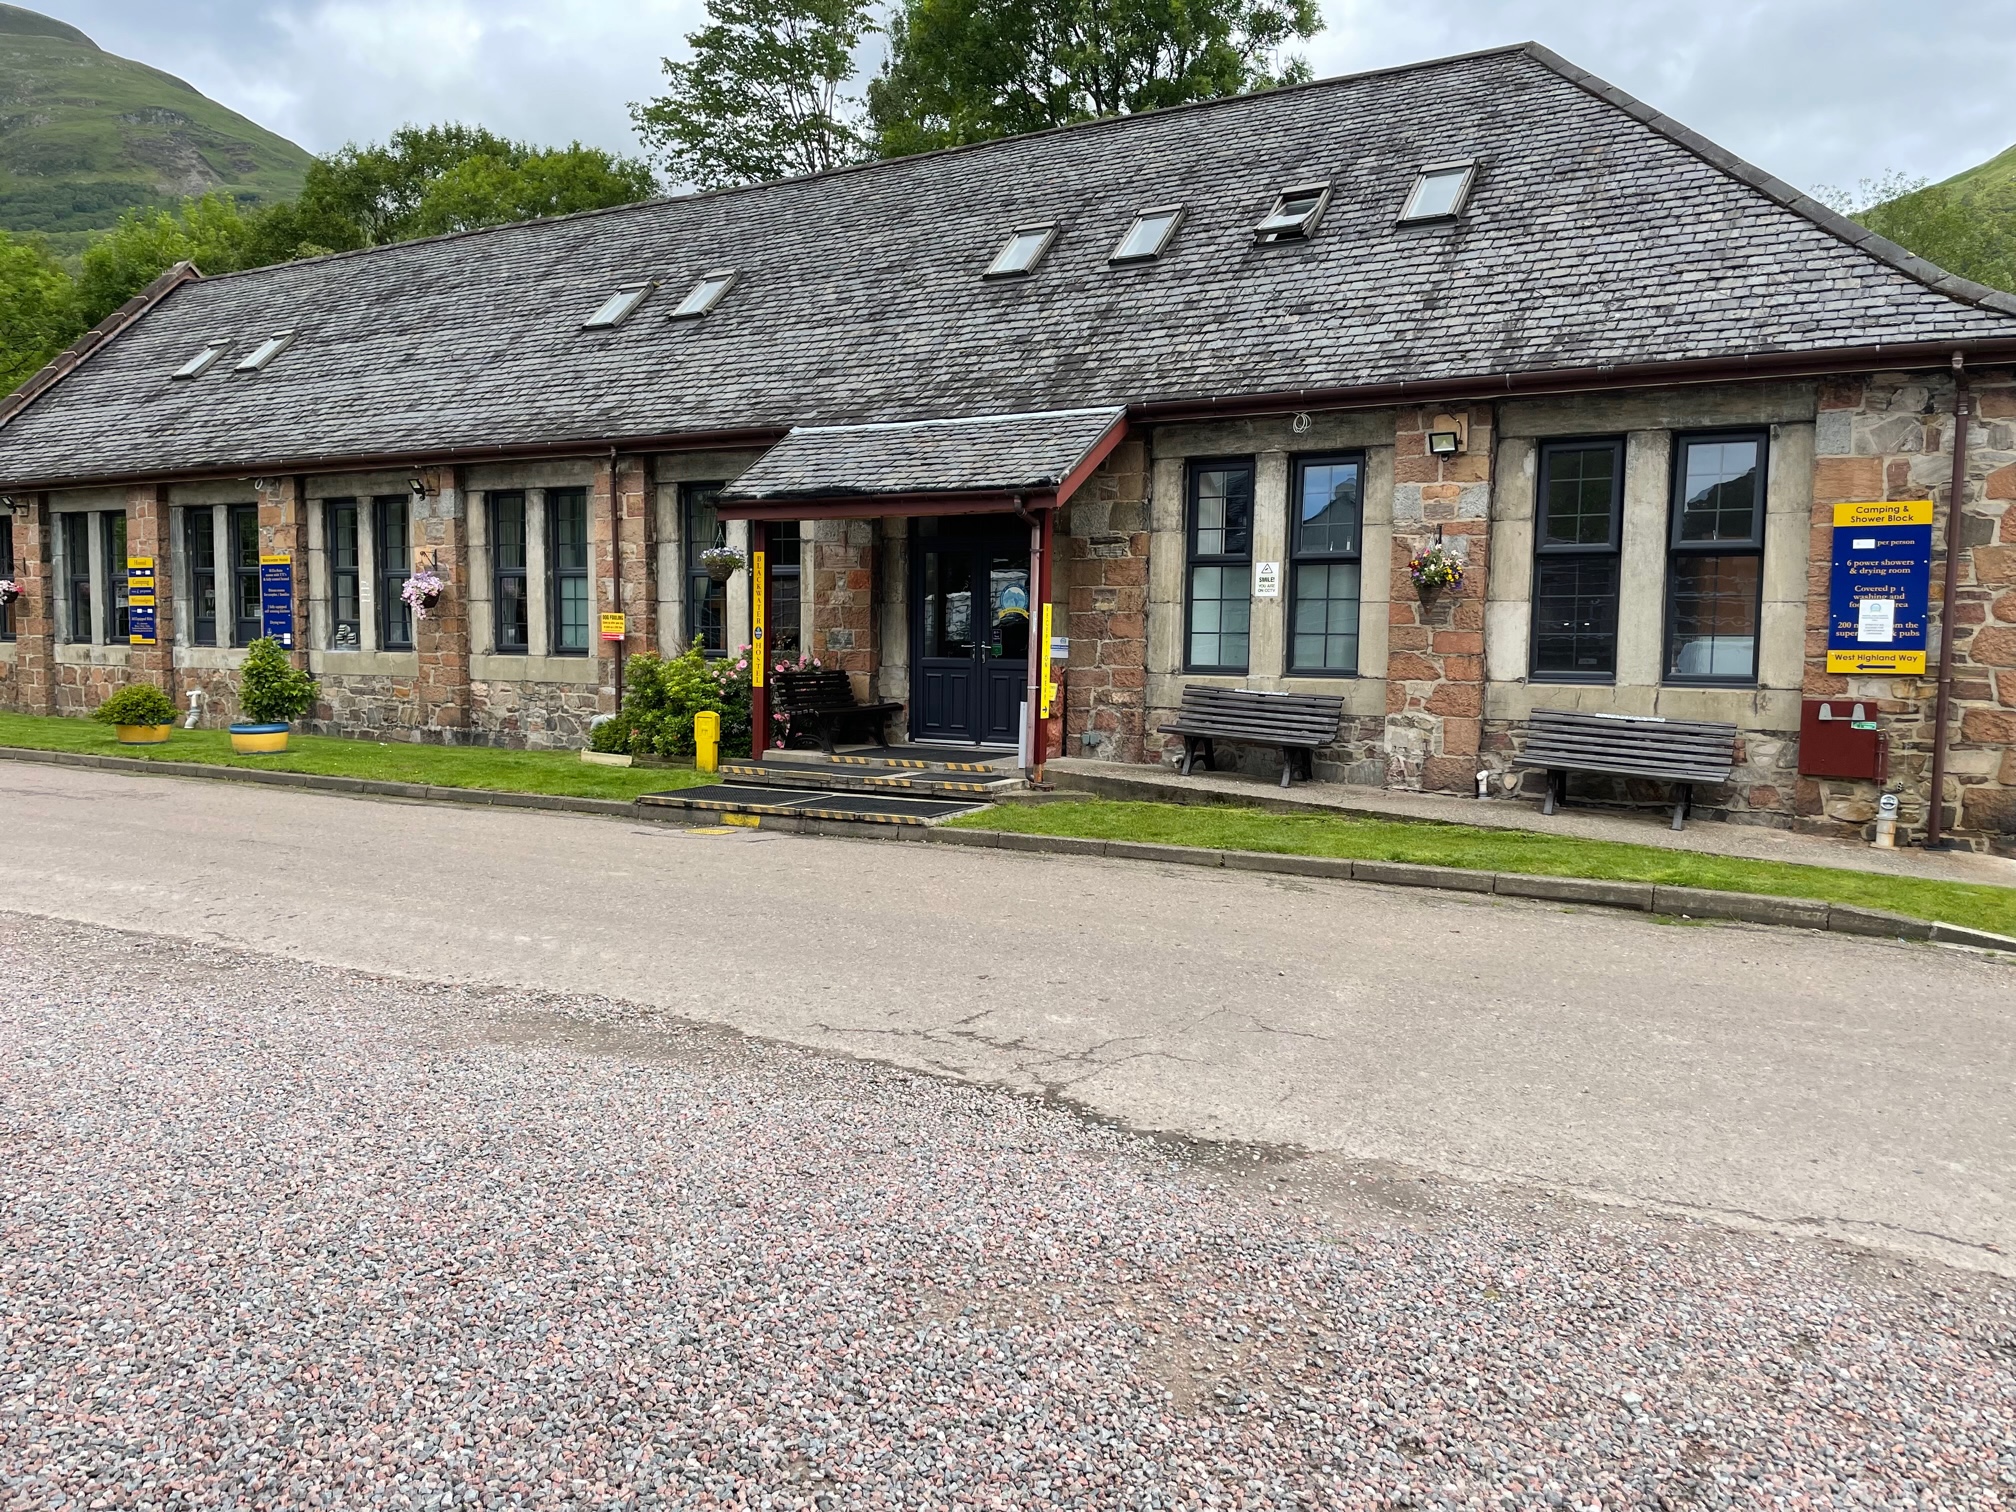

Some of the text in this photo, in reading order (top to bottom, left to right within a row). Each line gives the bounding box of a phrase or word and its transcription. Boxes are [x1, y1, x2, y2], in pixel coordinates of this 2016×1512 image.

[1855, 505, 1900, 514] Camping
[1850, 514, 1914, 523] Shower Block
[1890, 539, 1915, 547] person
[1846, 559, 1852, 567] 6
[1853, 560, 1879, 568] power
[1859, 567, 1887, 576] drying
[1837, 621, 1852, 629] 200
[1905, 621, 1919, 629] the
[1899, 629, 1920, 638] pubs
[1857, 654, 1896, 662] Highland
[1898, 654, 1918, 662] Way
